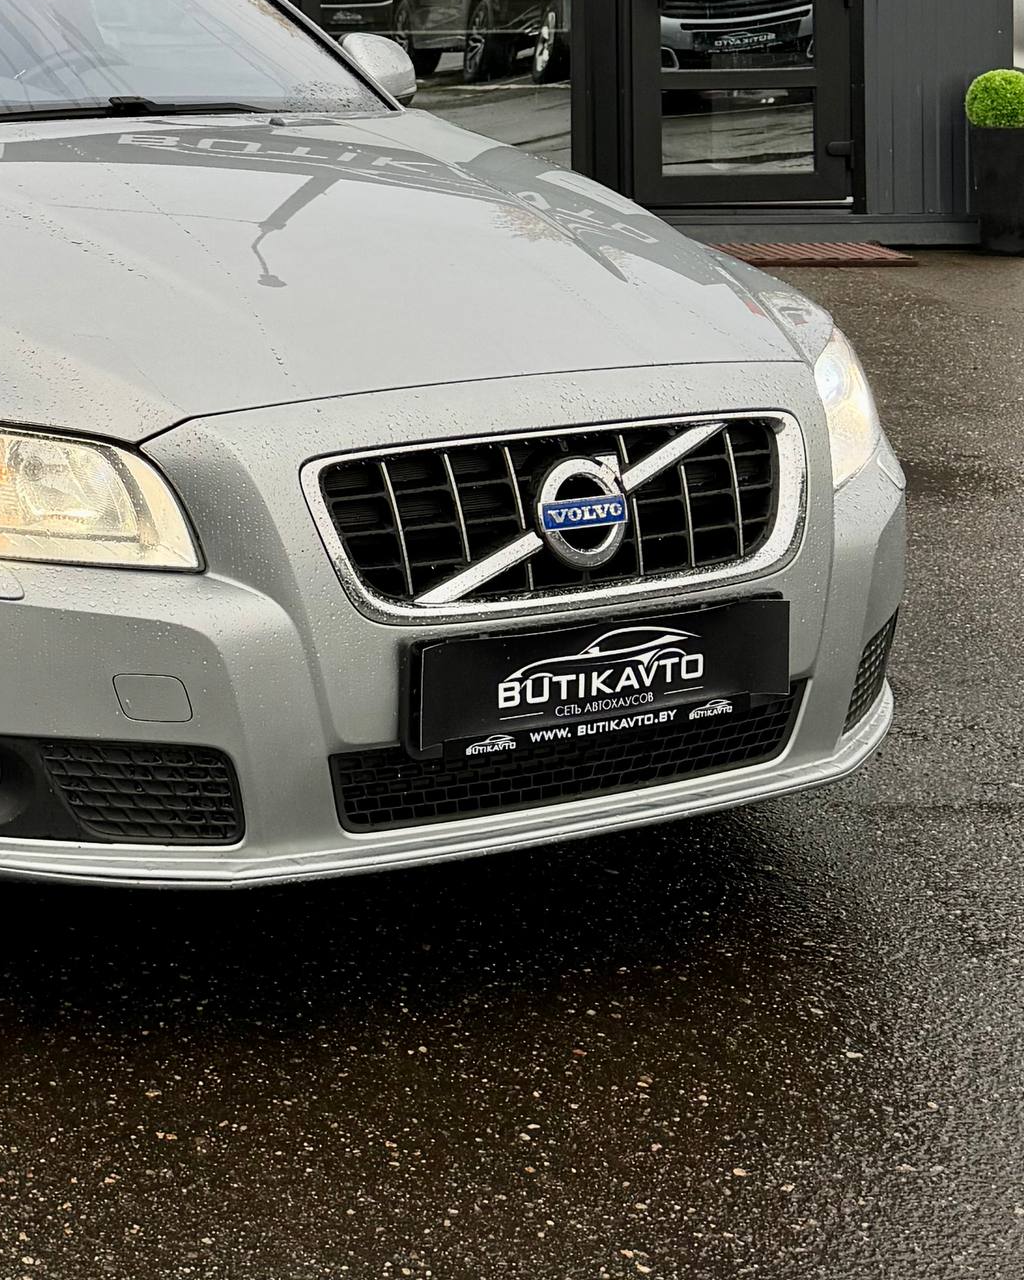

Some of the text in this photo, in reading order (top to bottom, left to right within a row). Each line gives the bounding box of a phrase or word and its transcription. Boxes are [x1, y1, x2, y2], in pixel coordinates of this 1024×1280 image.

[548, 501, 622, 524] VOLVO
[498, 653, 704, 709] BUTIKAVTO
[555, 691, 654, 717] СЕТЬ АВТОХАУСОВ
[689, 705, 733, 720] BUTIKAVTO
[577, 710, 677, 737] BUTIKAVTO.BY
[466, 742, 516, 756] BUTIKAVTO
